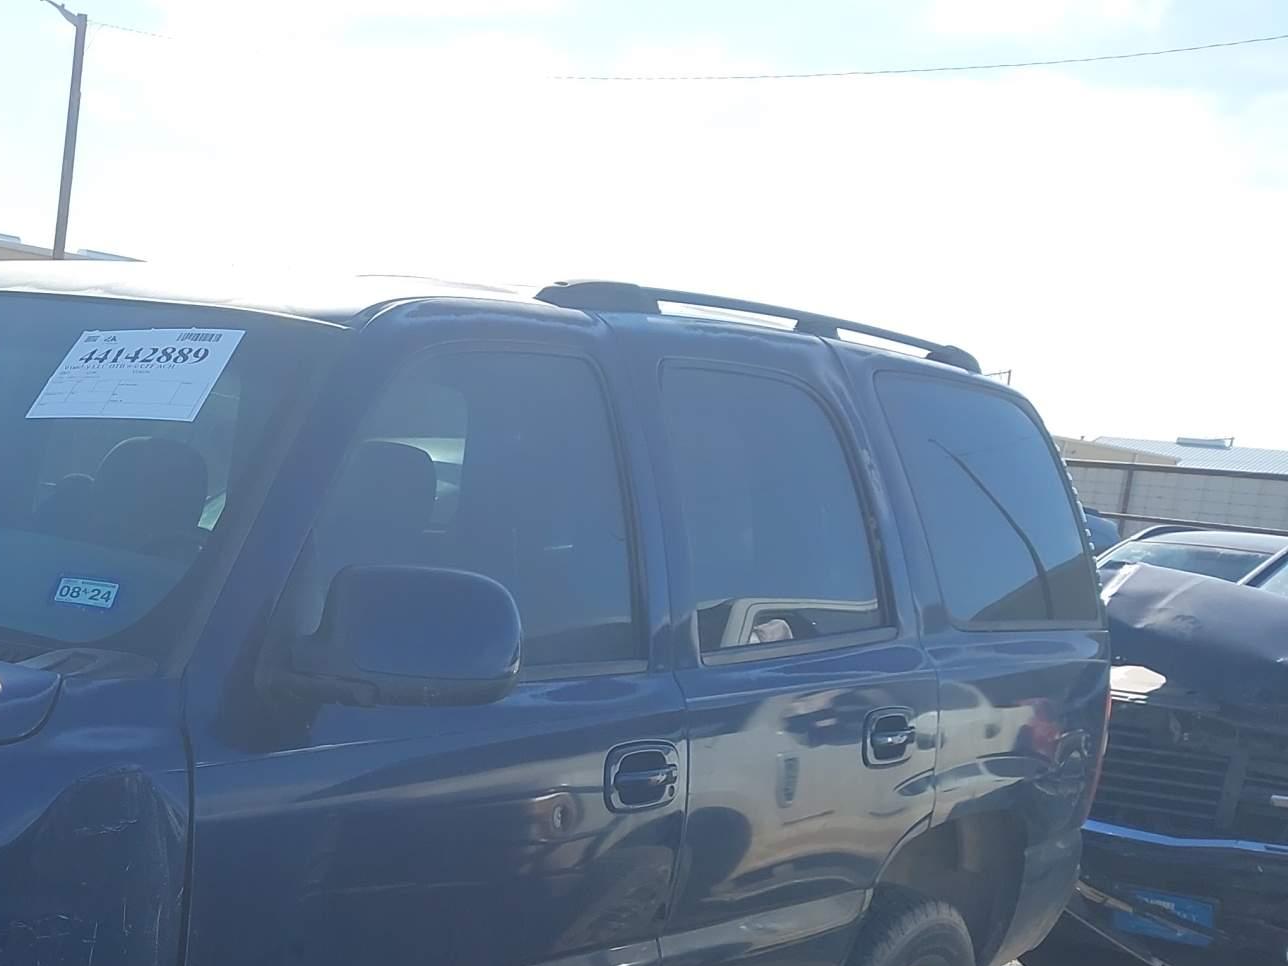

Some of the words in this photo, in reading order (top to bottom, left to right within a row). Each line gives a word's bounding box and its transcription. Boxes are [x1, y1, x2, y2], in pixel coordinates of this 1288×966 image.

[78, 346, 210, 365] 44142889
[59, 585, 82, 599] 08
[88, 588, 112, 603] 24
